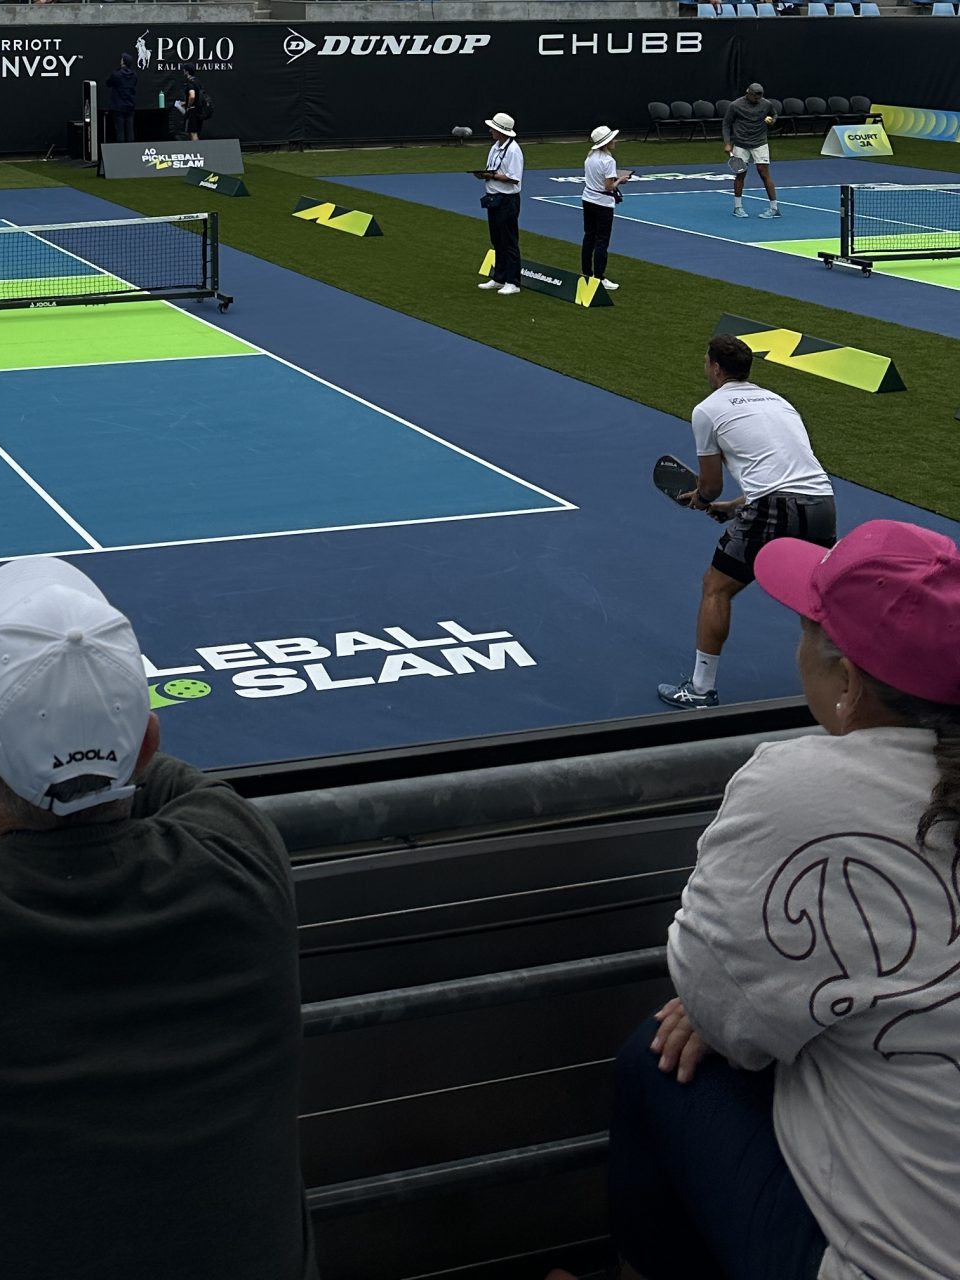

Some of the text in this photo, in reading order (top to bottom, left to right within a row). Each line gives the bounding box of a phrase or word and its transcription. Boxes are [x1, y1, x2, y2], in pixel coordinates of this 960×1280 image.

[156, 37, 234, 61] POLO
[317, 35, 491, 55] DUNLOP
[539, 32, 703, 55] CHUBB
[196, 63, 233, 71] LAUREN
[847, 133, 878, 141] COURT
[142, 153, 204, 162] PICKLEBALL
[172, 160, 204, 168] SLAM
[141, 620, 514, 678] LEBALL
[232, 640, 538, 699] SLAM
[66, 749, 118, 765] JOOLA
